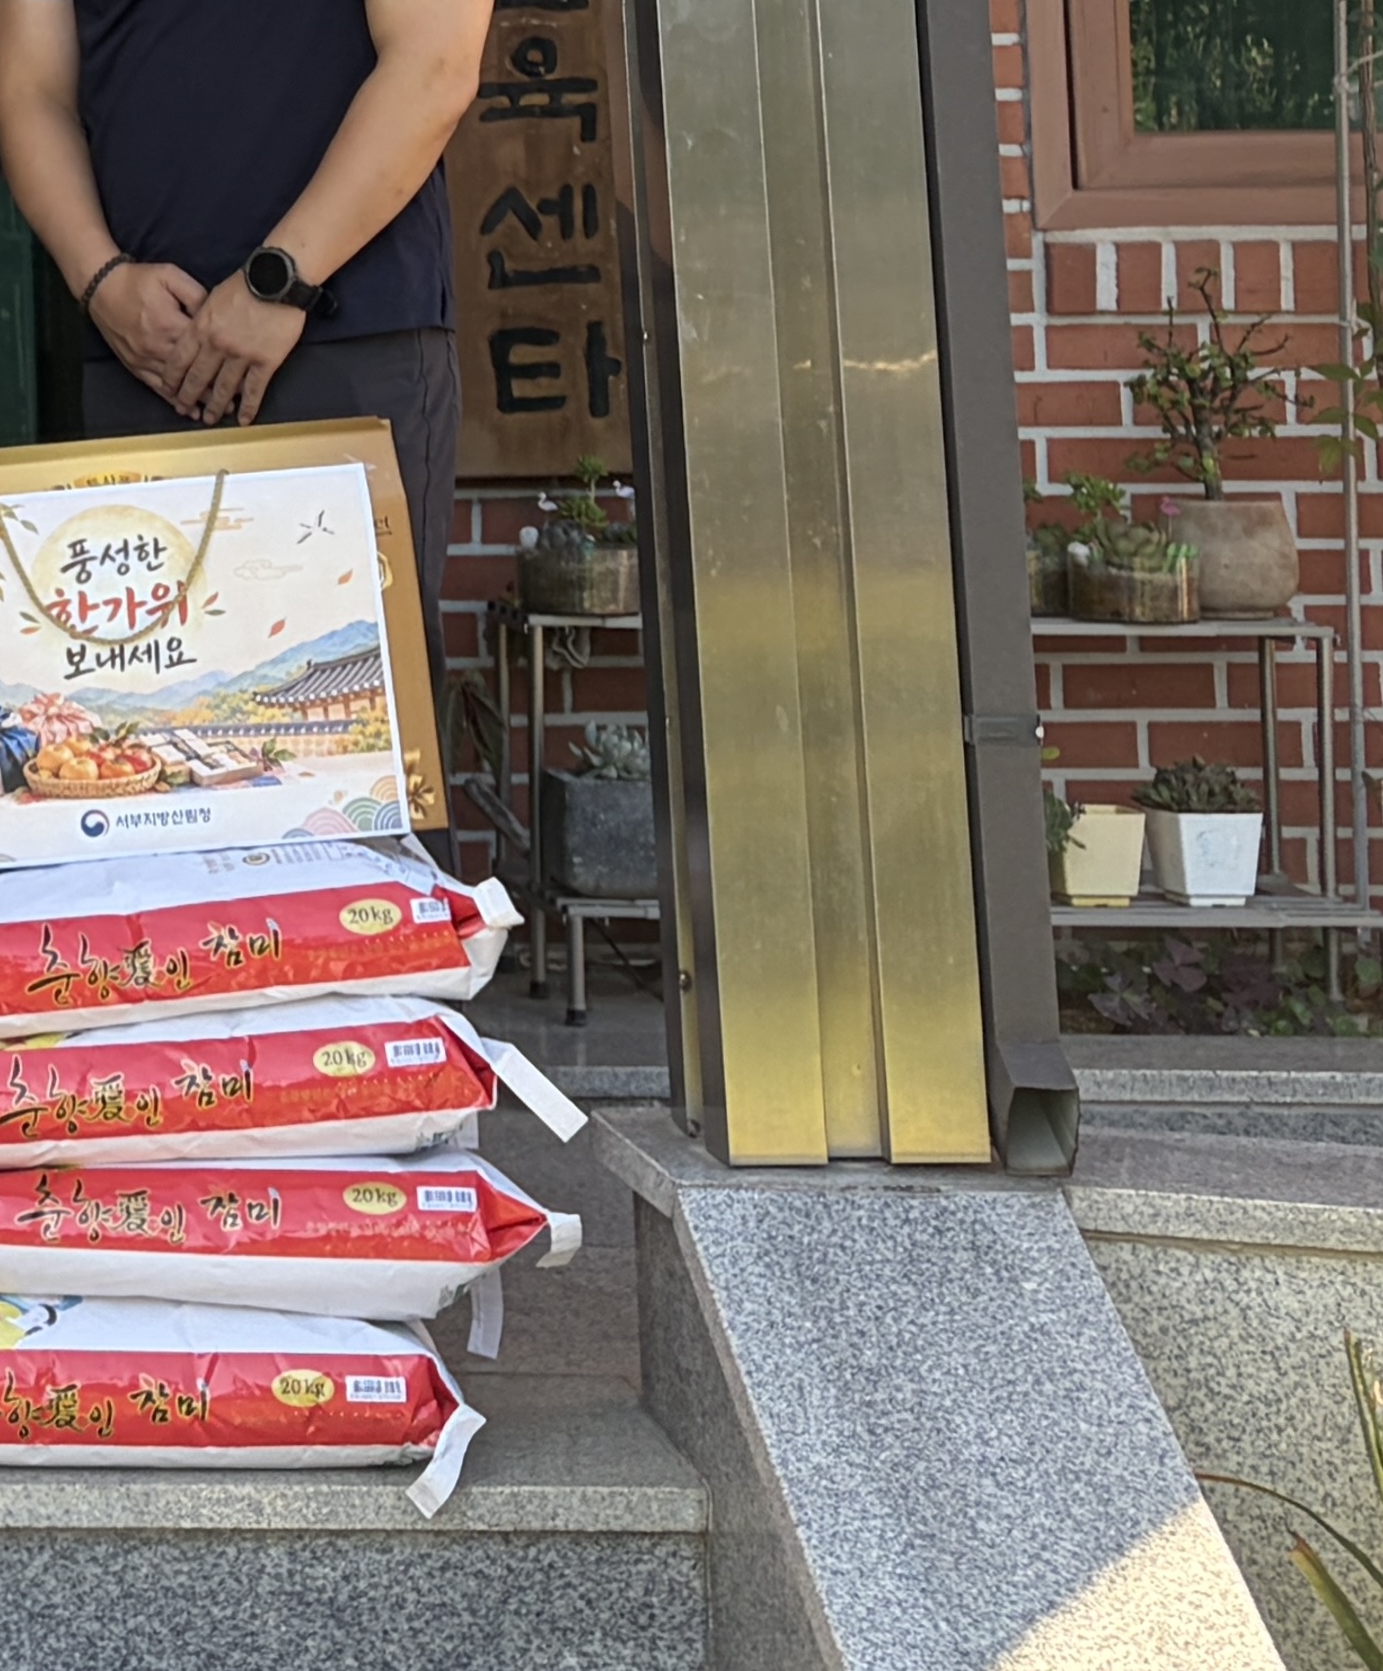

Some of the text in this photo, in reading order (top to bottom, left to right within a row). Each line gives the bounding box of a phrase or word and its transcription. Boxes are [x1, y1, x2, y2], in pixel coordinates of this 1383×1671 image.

[59, 533, 169, 585] 풍성한
[46, 583, 190, 637] 한가위
[62, 636, 198, 681] 보내세요
[115, 806, 212, 831] 서부지방산림청
